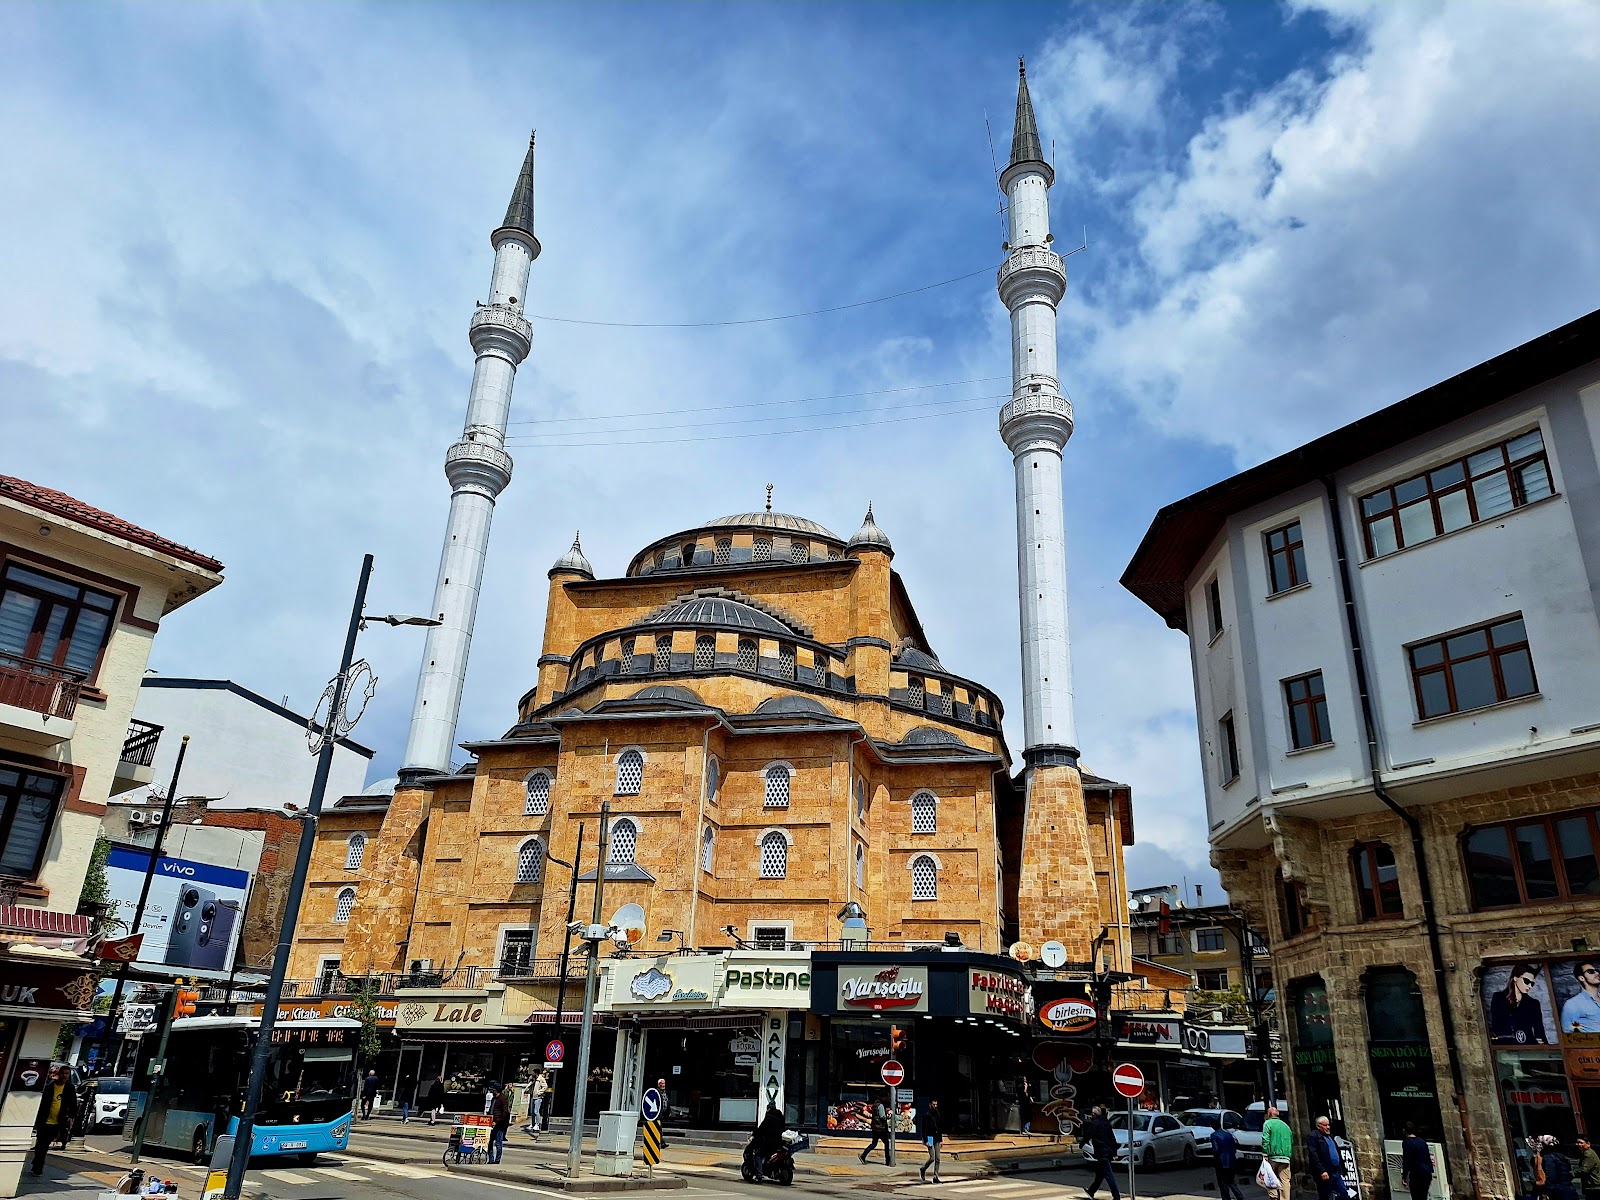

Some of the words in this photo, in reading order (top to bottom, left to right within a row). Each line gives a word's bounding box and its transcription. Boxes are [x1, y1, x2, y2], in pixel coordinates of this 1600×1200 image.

[163, 862, 195, 876] vivo
[726, 968, 810, 989] Pastane
[842, 977, 922, 998] Yarışoğlu
[433, 1003, 483, 1022] Lale
[1055, 1006, 1091, 1019] birleşim
[856, 1047, 890, 1058] Yarışoğlu
